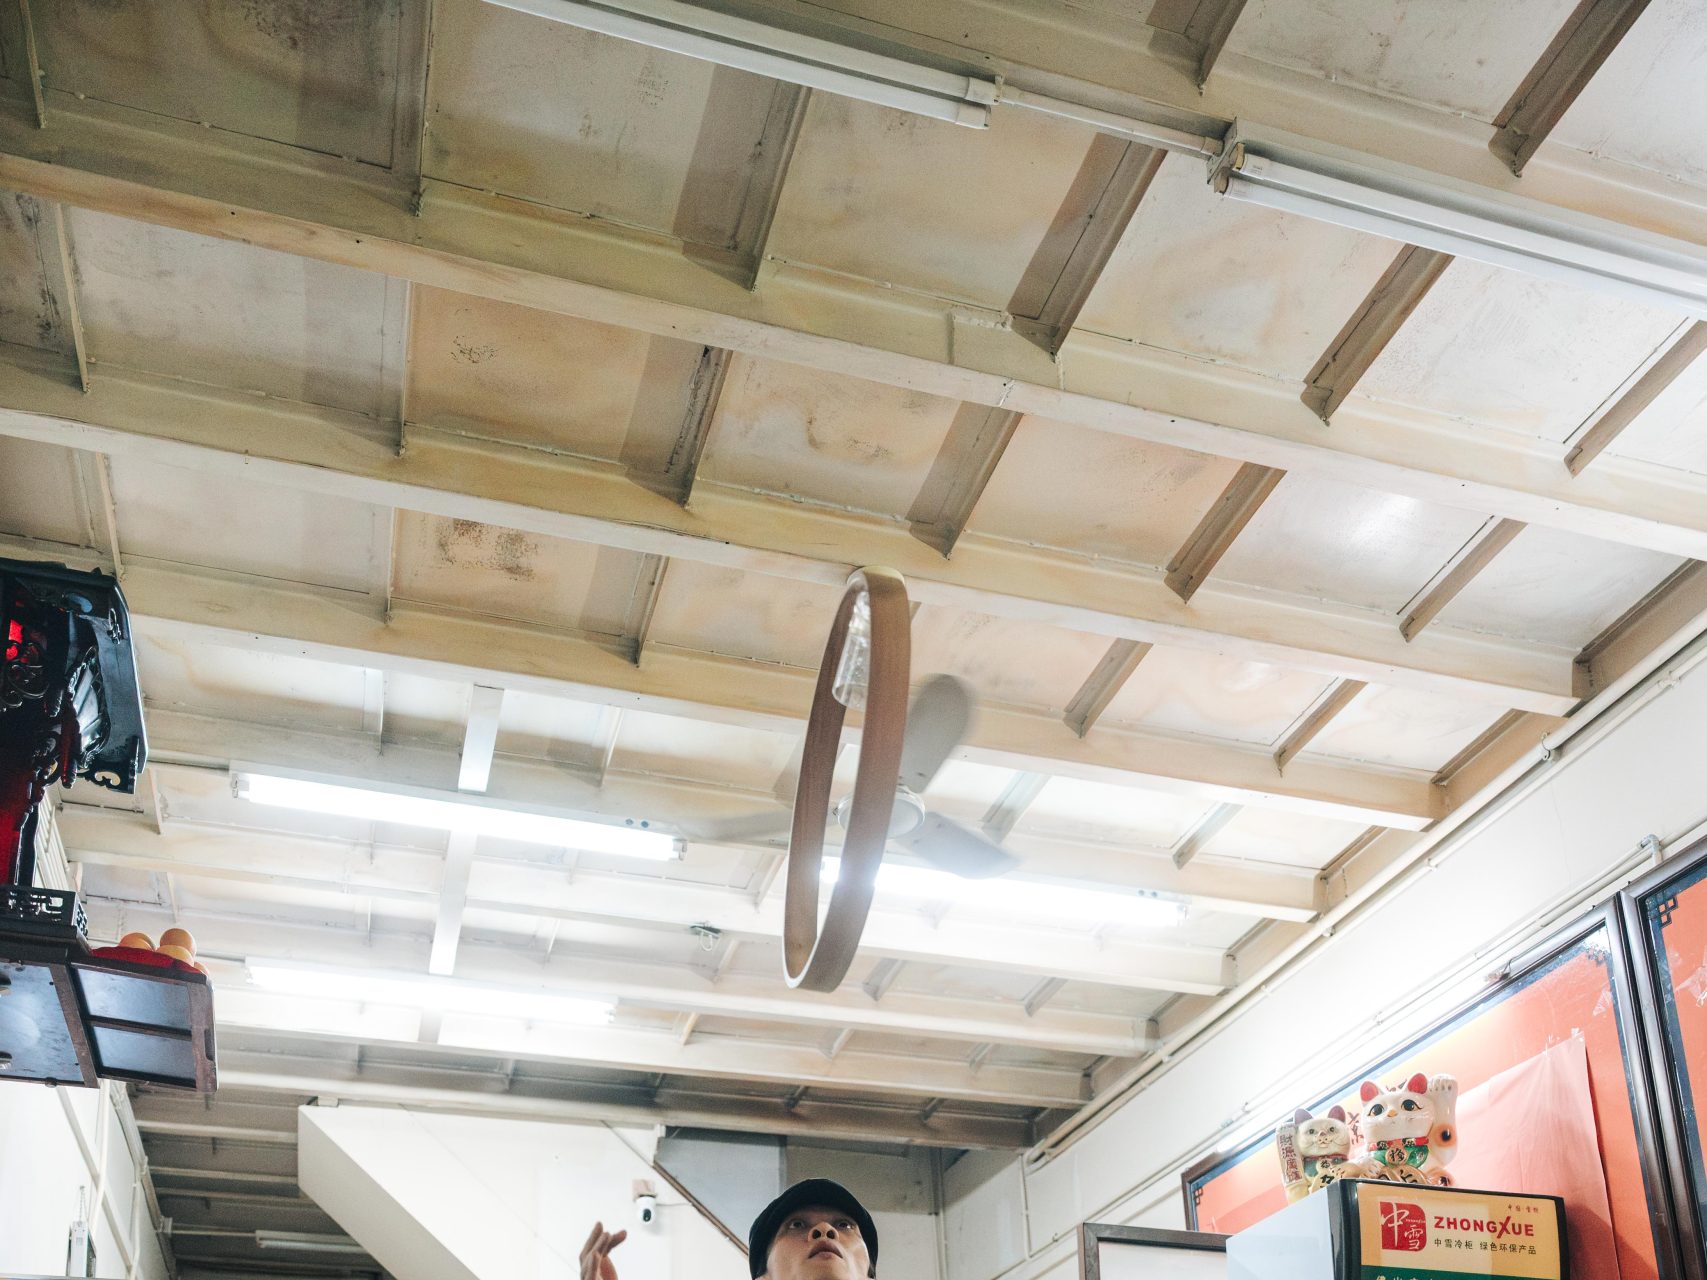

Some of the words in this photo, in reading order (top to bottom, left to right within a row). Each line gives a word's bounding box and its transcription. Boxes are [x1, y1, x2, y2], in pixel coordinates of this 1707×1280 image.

[1434, 1216, 1534, 1238] ZHONGXUE
[1434, 1238, 1473, 1250] 中雪冷柜
[1480, 1241, 1536, 1254] 绿色环保产品
